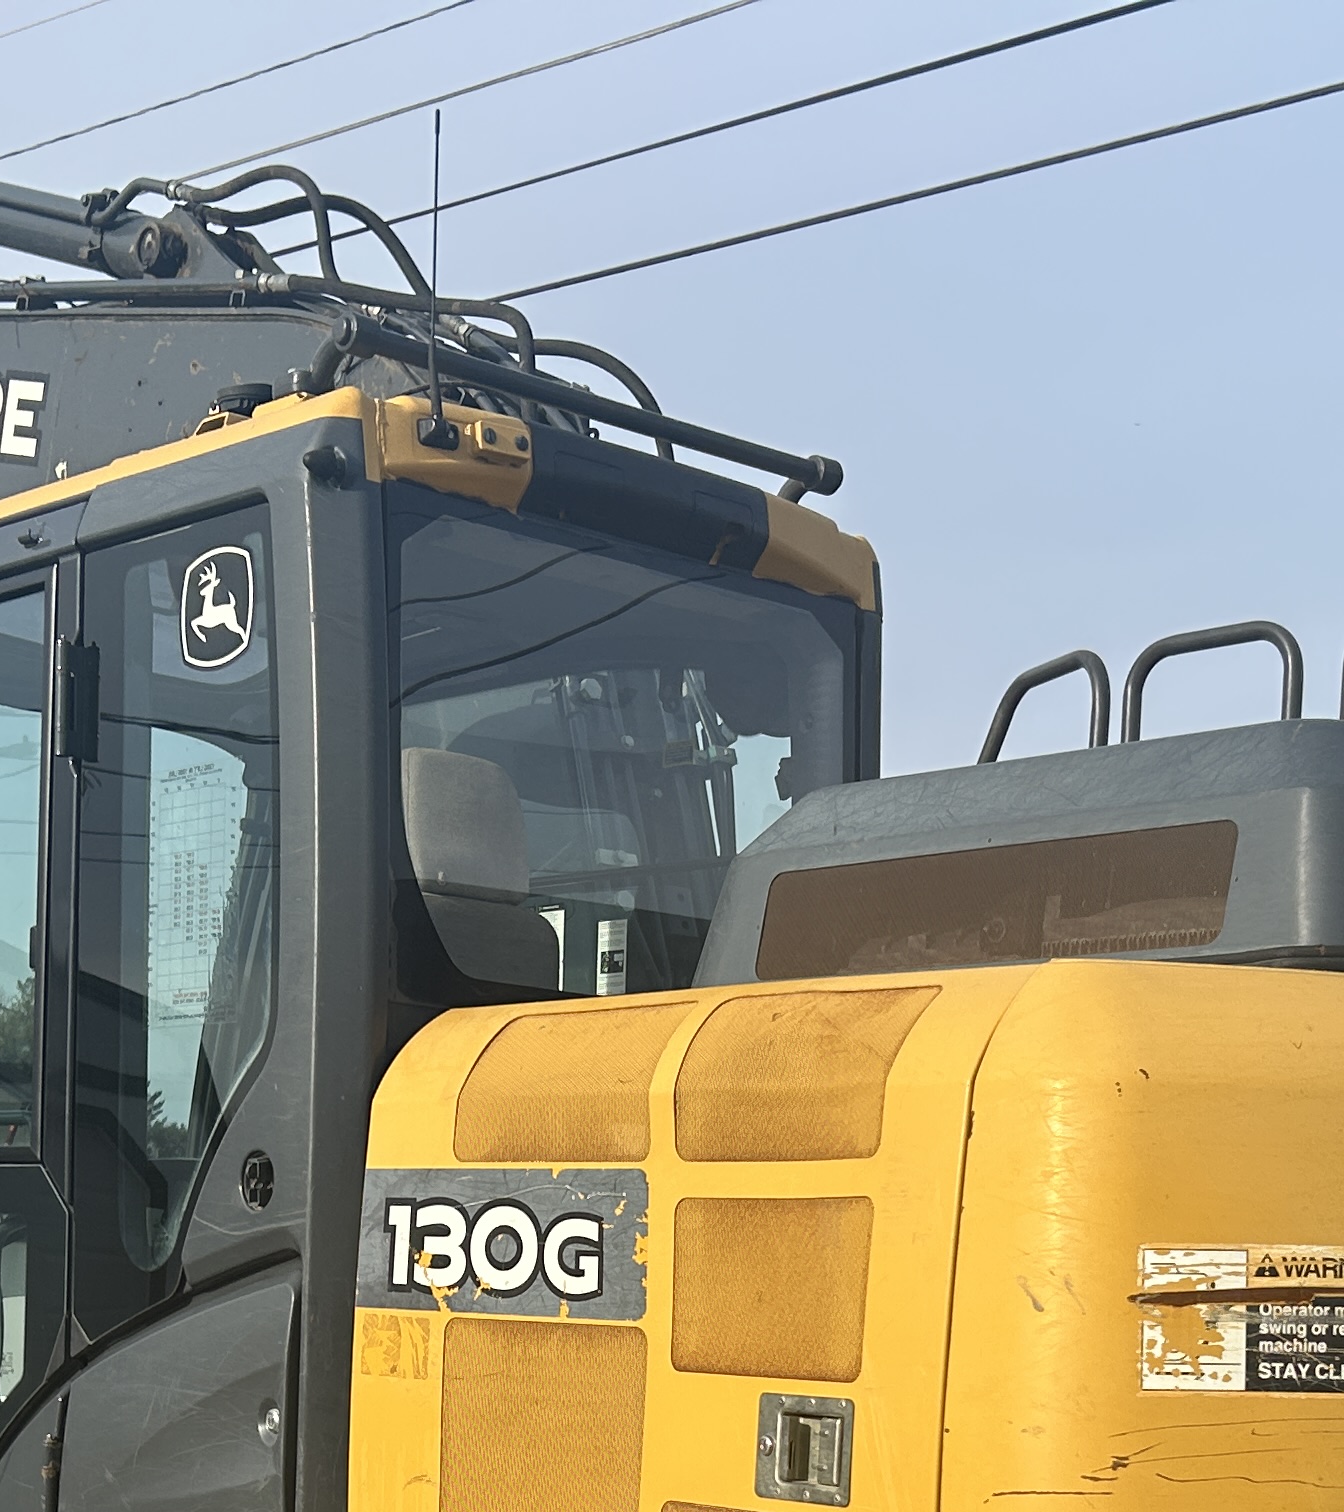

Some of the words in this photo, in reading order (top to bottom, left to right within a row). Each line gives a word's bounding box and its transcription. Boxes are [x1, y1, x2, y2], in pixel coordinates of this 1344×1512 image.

[387, 1204, 600, 1295] 130G
[1258, 1302, 1331, 1320] Operator
[1258, 1321, 1308, 1339] swing
[1310, 1323, 1329, 1336] or
[1258, 1338, 1328, 1354] machine
[1257, 1362, 1311, 1380] STAY
